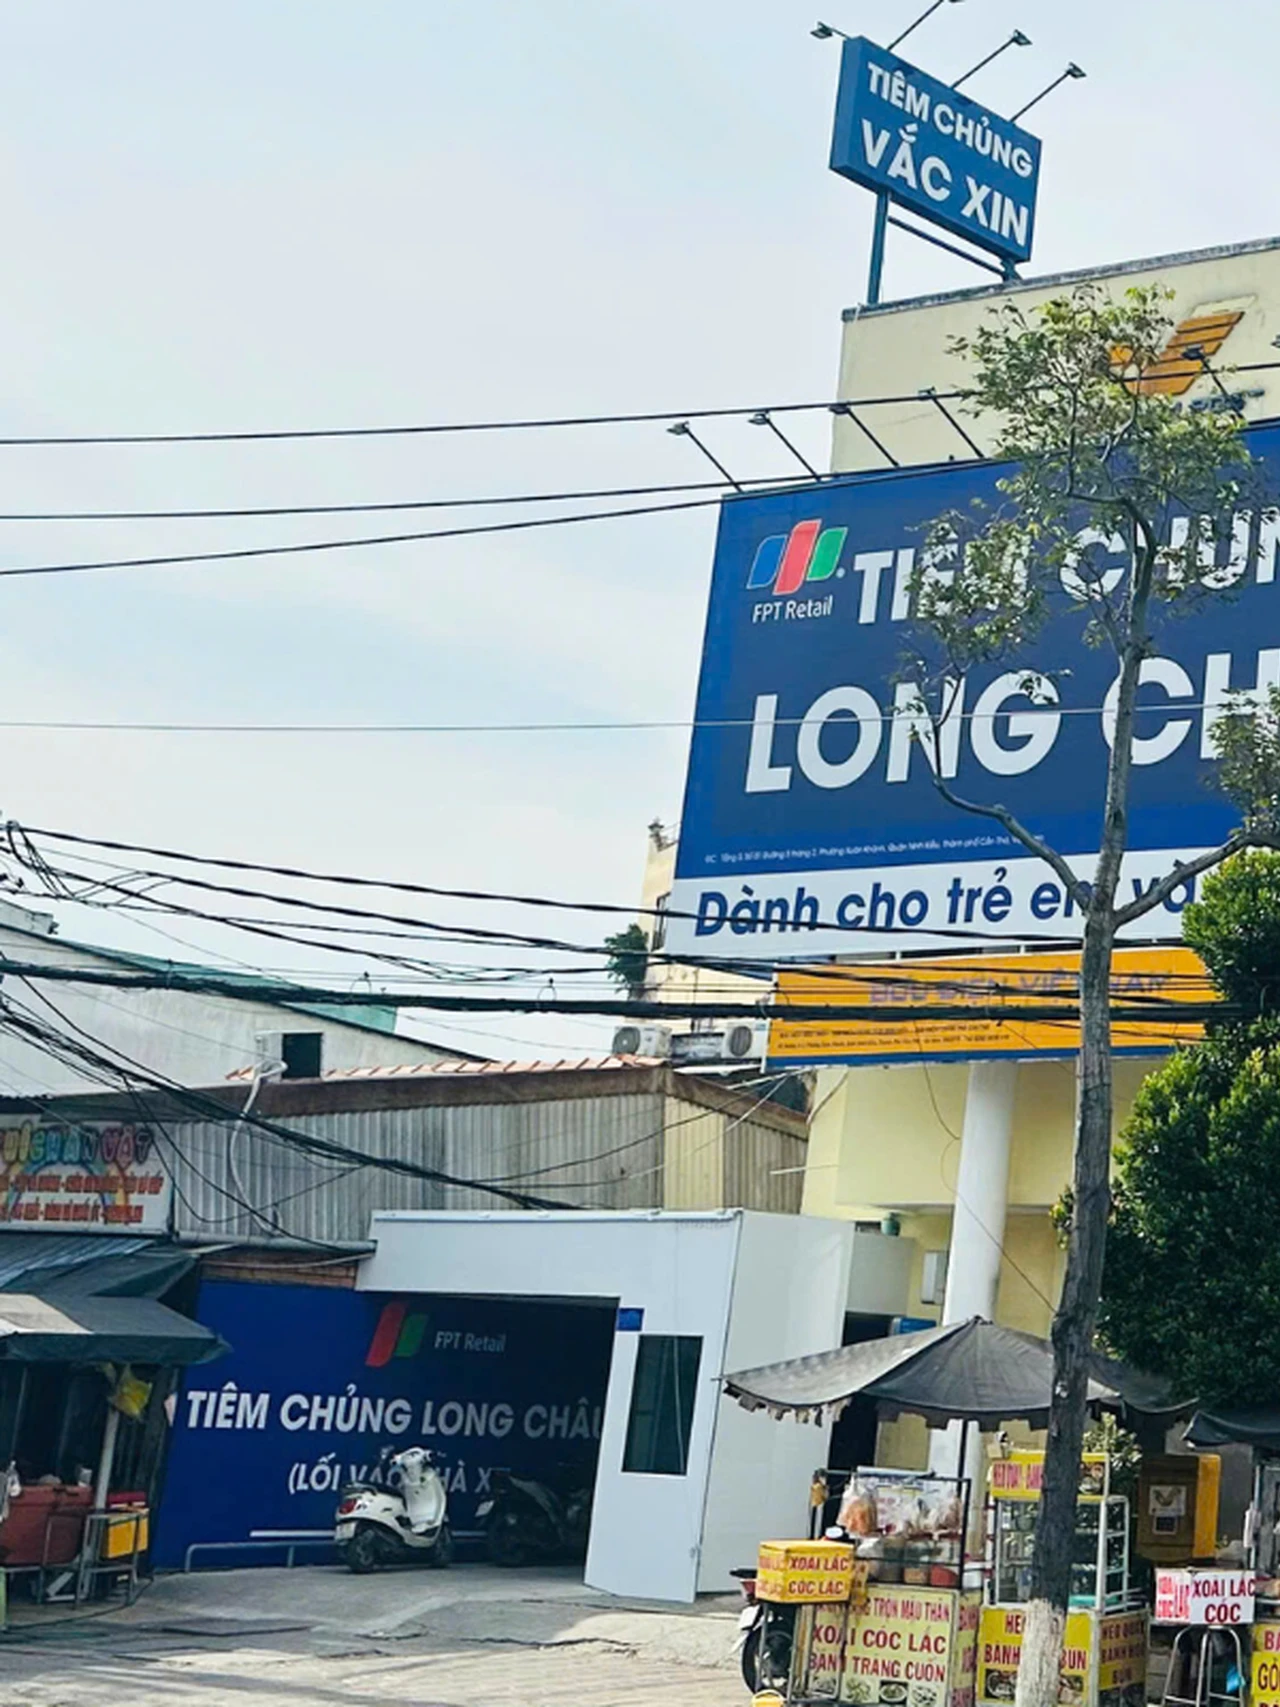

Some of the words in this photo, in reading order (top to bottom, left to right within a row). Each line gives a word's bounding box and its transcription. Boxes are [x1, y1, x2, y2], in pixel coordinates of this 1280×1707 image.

[867, 62, 930, 123] TIÊM
[932, 102, 1034, 179] CHỦNG
[861, 118, 952, 202] VẮC
[960, 175, 1029, 247] XIN
[752, 602, 783, 624] FPT
[785, 595, 833, 620] Retail
[745, 668, 1062, 793] LONG
[695, 885, 819, 937] Dành
[836, 883, 929, 929] cho
[947, 867, 1013, 924] trẻ
[434, 1331, 461, 1349] FPT
[464, 1332, 507, 1352] Retail
[187, 1381, 270, 1429] TIÊM
[280, 1384, 412, 1434] CHỦNG
[422, 1400, 514, 1437] LONG
[289, 1452, 341, 1495] (LỐI
[1204, 1598, 1241, 1623] CÓC
